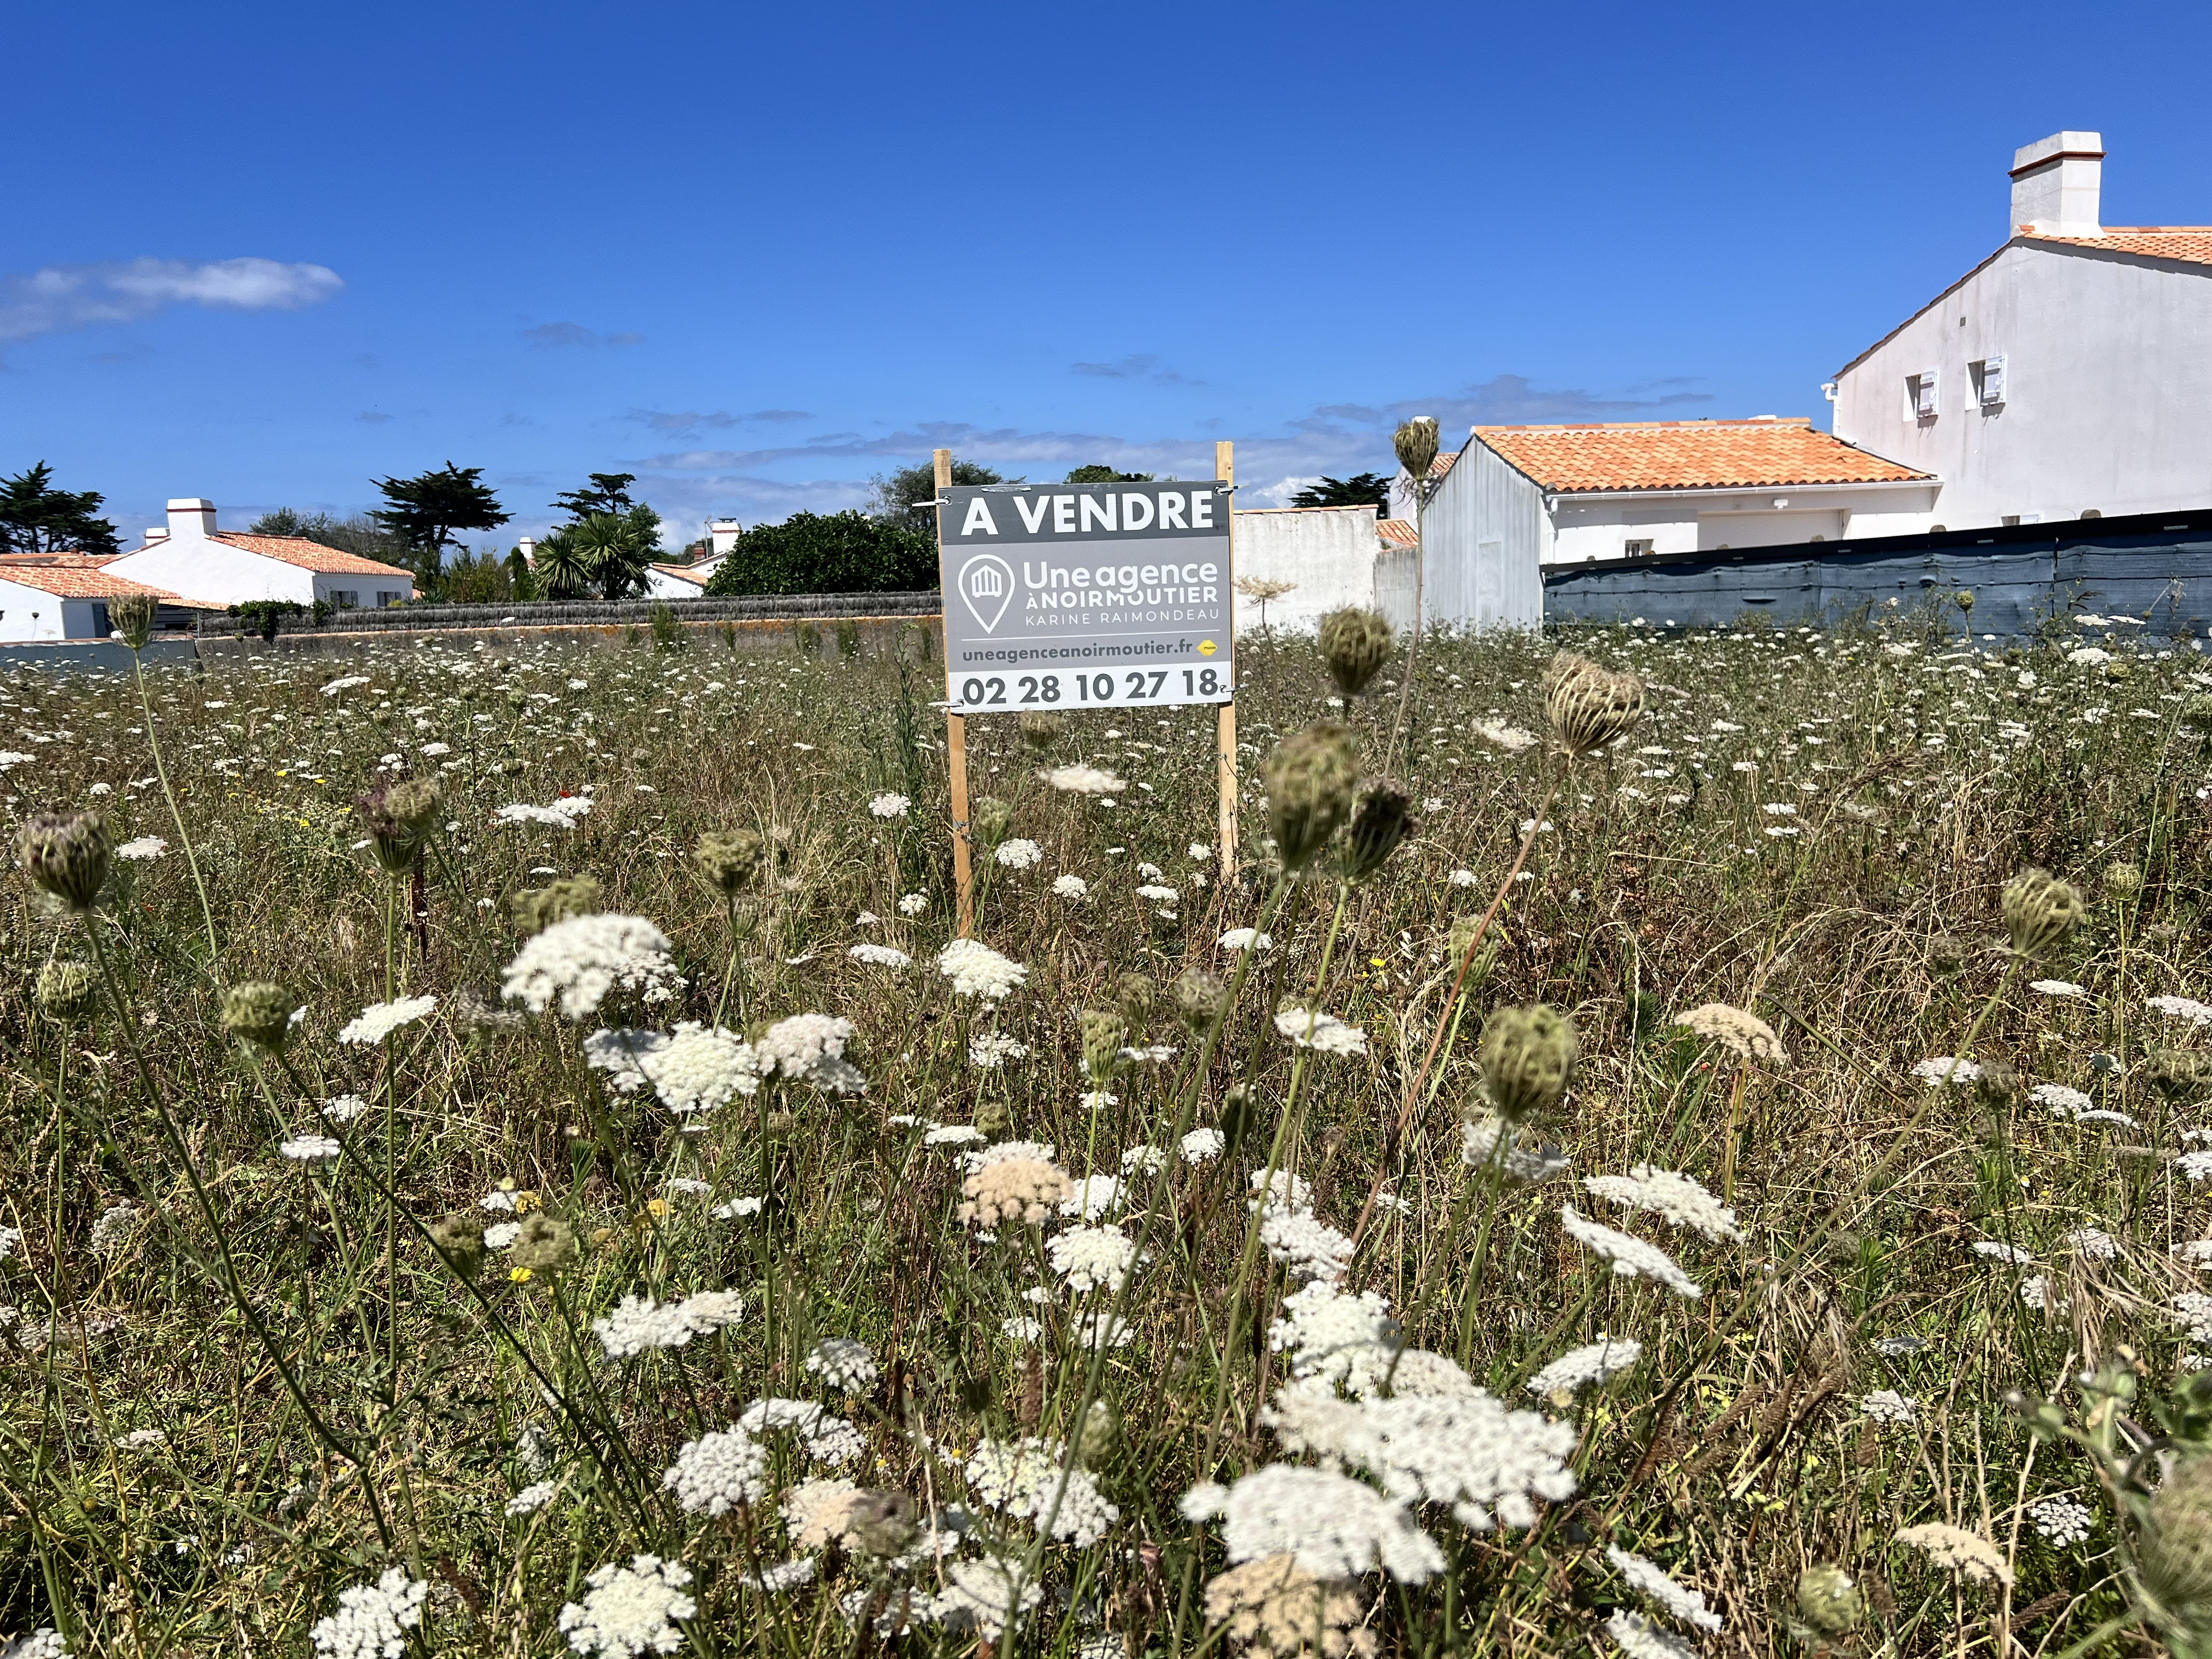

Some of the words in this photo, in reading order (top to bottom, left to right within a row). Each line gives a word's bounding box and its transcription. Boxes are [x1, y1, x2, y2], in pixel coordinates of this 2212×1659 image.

[961, 497, 999, 536] A
[1013, 490, 1213, 534] VENDRE
[1024, 561, 1090, 589] Une
[1095, 563, 1218, 594] agence
[1025, 613, 1091, 626] KARINE
[1101, 608, 1219, 623] RAIMONDEAU
[962, 639, 1193, 664] uneagenceanoirmoutier.fr
[963, 678, 1007, 706] 02
[1018, 675, 1060, 703] 28
[1076, 673, 1114, 701] 10
[1126, 671, 1169, 699] 27
[1182, 669, 1218, 697] 18
